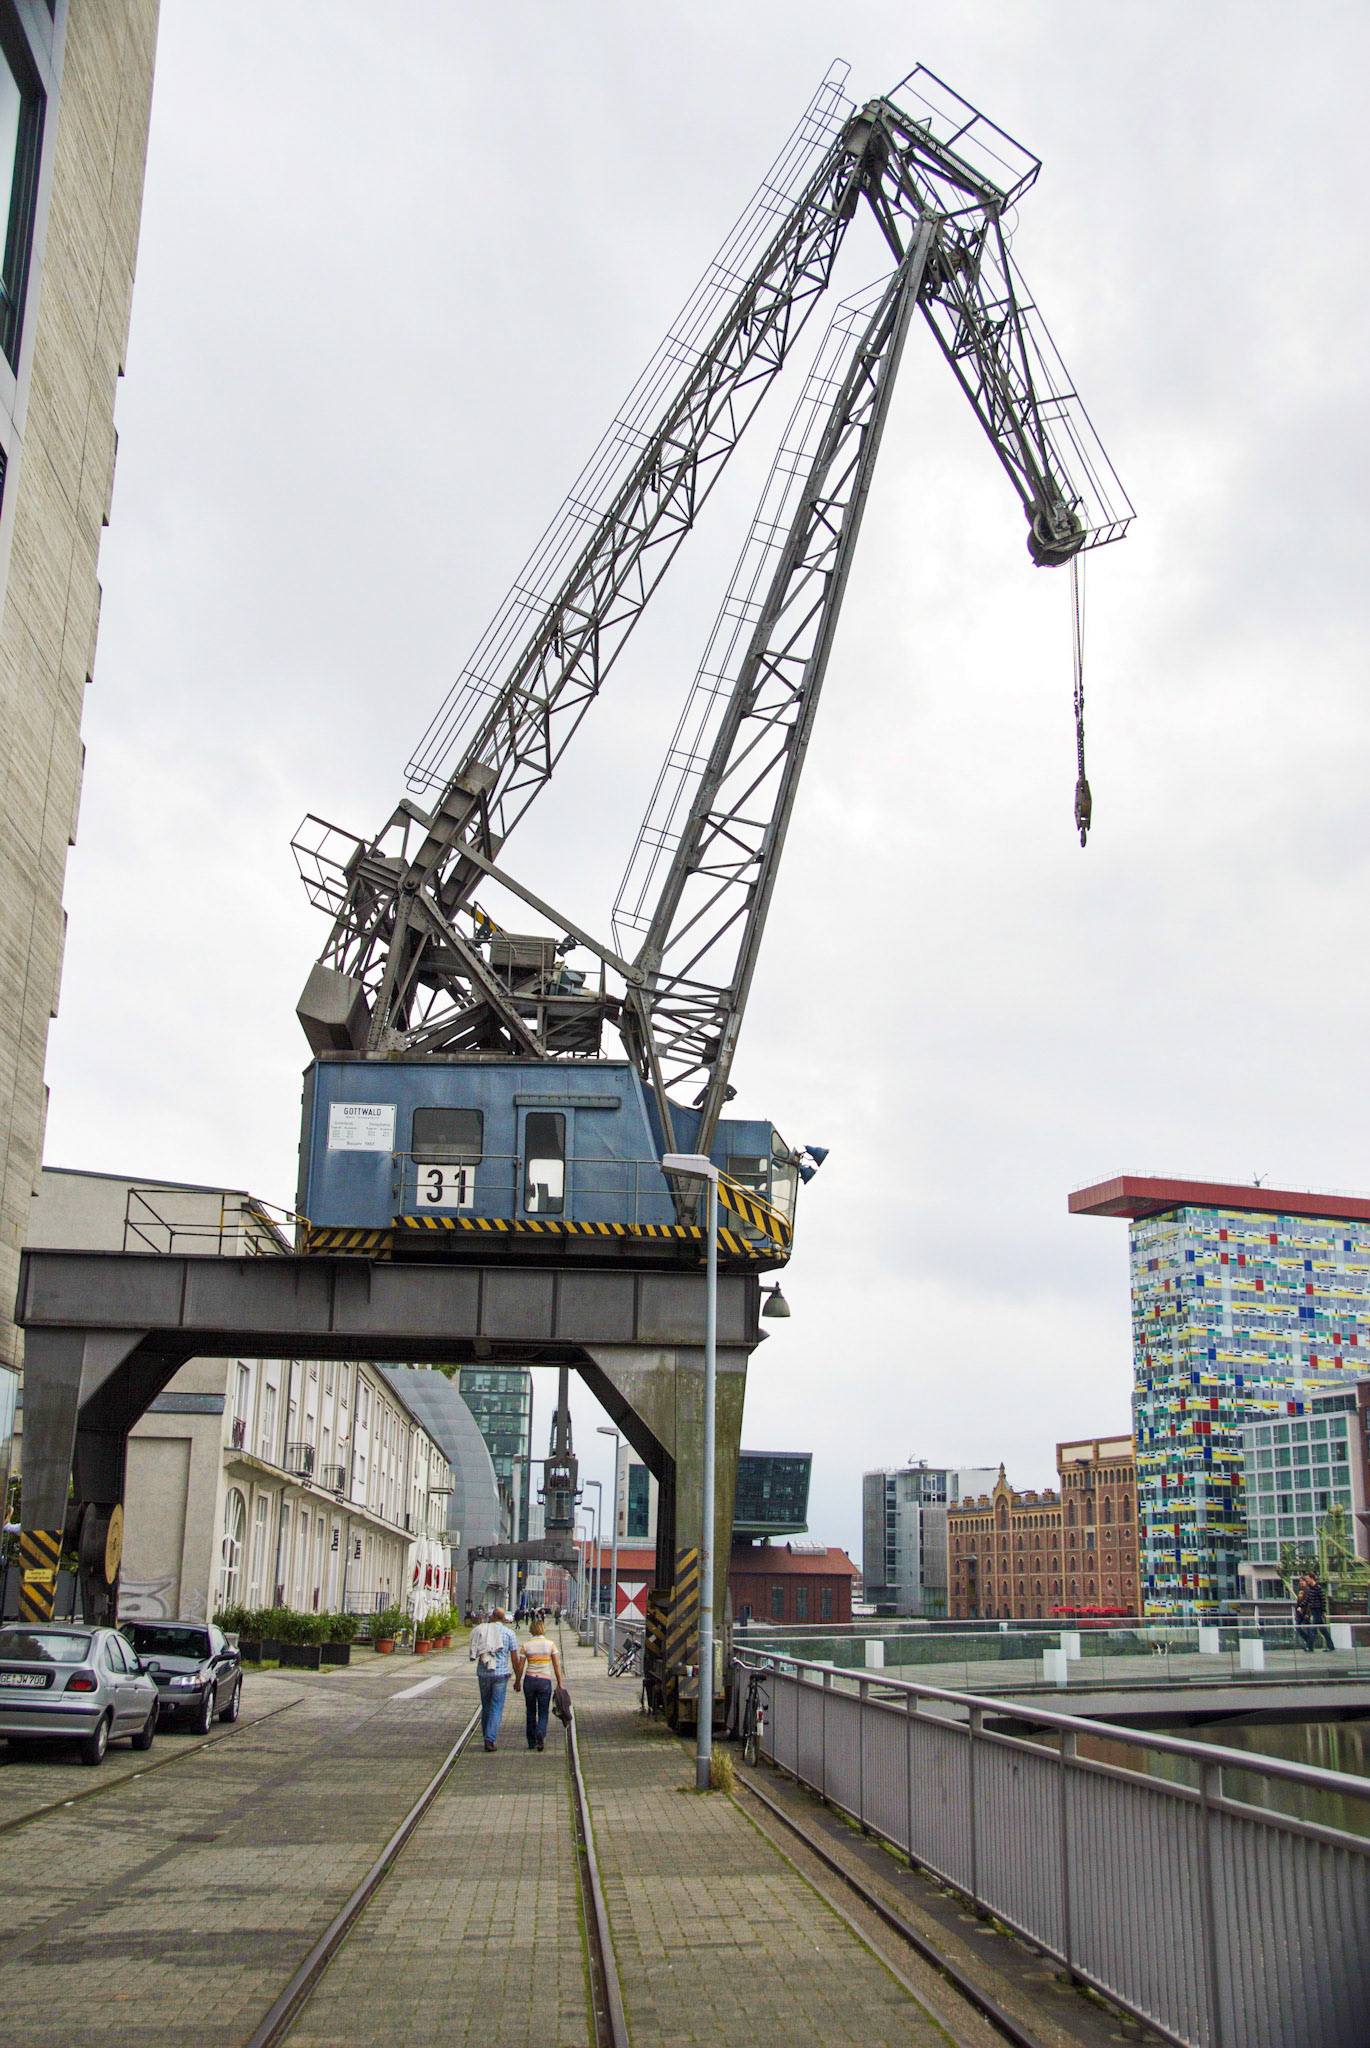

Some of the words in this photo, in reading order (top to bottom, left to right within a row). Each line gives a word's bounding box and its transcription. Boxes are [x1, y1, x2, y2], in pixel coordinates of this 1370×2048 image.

[343, 1107, 382, 1116] GOTTWALD
[426, 1169, 466, 1203] 31
[29, 1675, 46, 1685] 700
